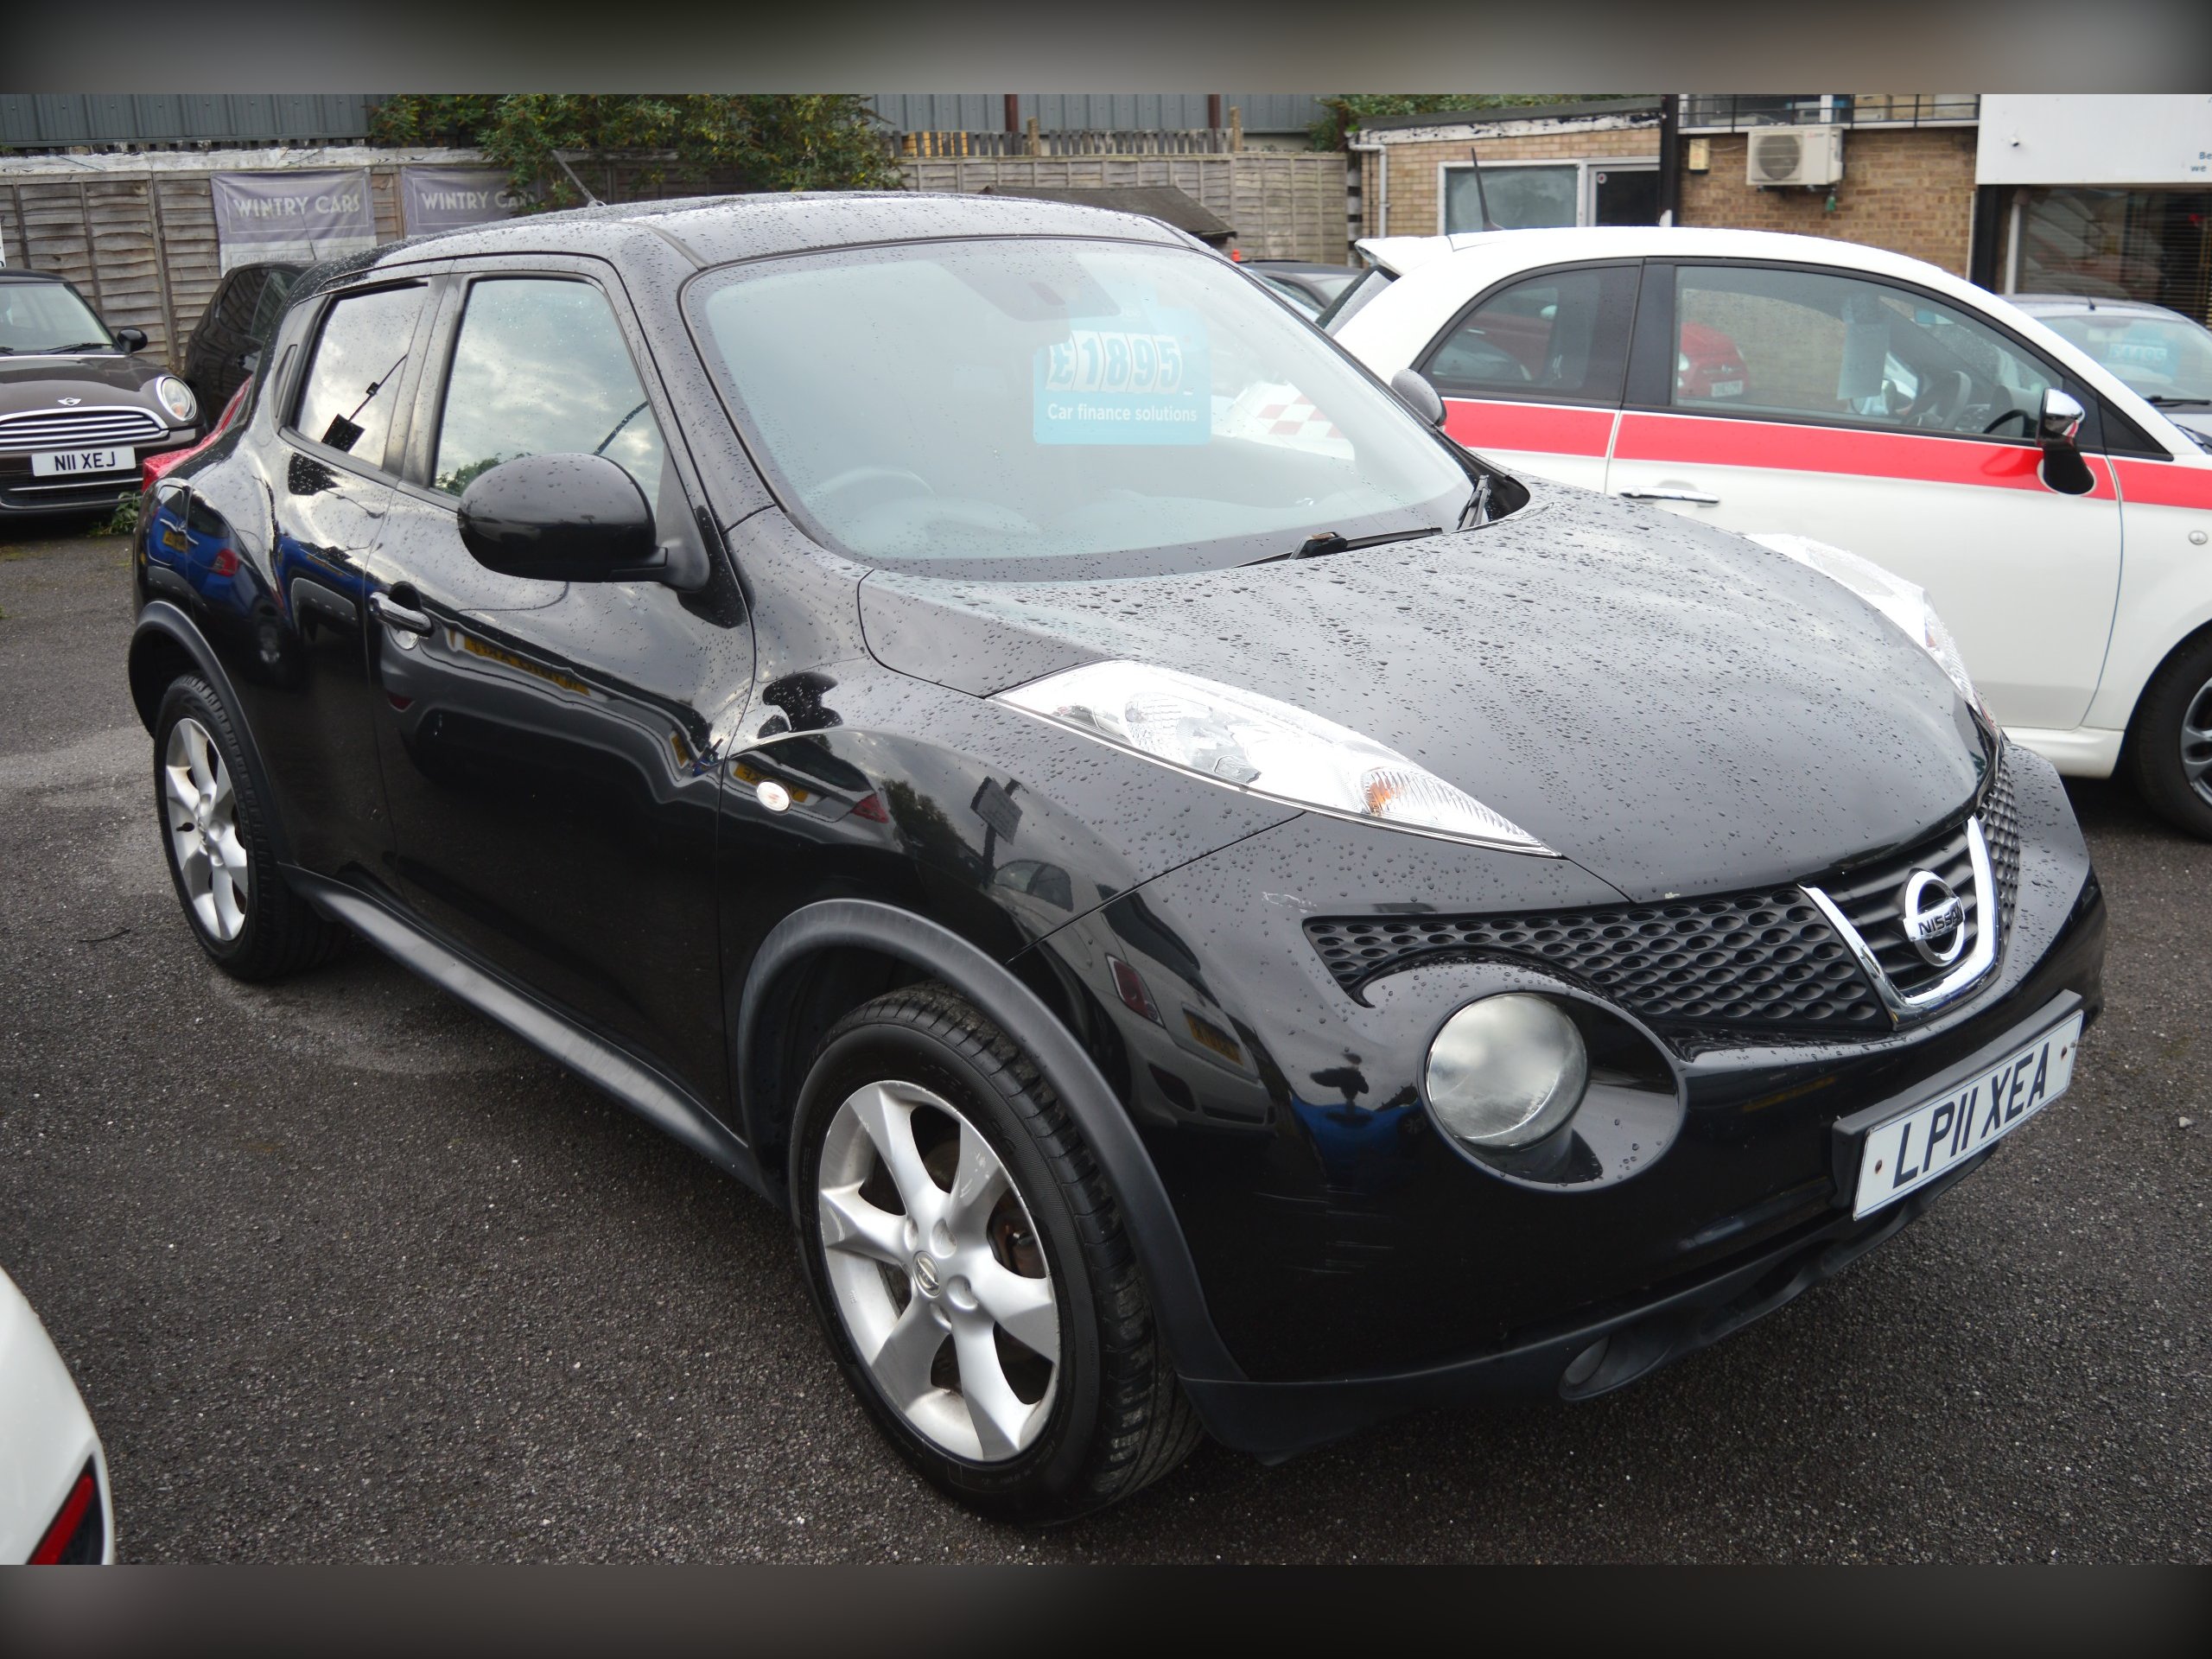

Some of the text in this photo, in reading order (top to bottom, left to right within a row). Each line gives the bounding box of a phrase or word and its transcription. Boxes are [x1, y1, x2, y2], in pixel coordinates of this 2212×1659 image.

[232, 194, 360, 217] WINTRY CARS
[421, 191, 488, 210] WINTRY
[1049, 337, 1181, 388] £1895
[1047, 404, 1198, 422] Car finance solutions
[81, 451, 116, 469] XEJ
[1917, 901, 1964, 936] NISSAN
[1892, 1041, 2050, 1189] LP11 XEA
